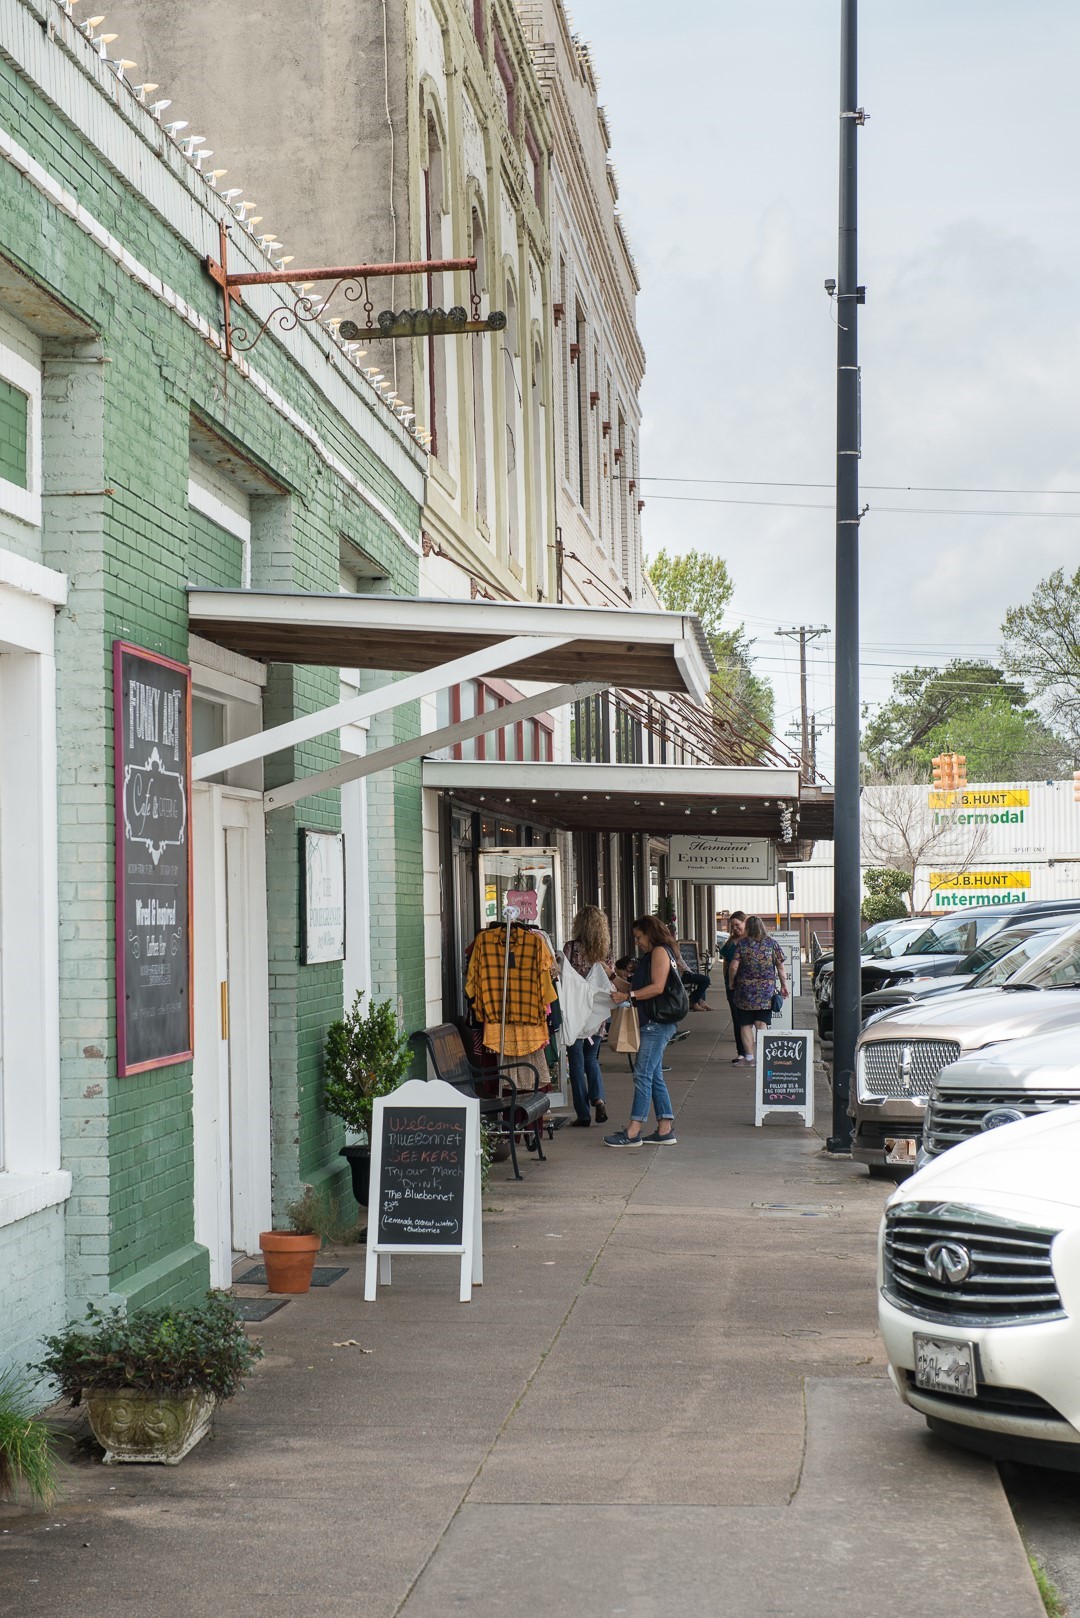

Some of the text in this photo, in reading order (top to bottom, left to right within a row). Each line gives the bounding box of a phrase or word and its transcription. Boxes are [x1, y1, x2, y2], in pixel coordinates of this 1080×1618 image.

[129, 680, 181, 762] FUNKY ART
[689, 841, 748, 852] Hermann
[678, 853, 760, 865] Emporium
[935, 891, 1026, 906] Intermodal
[135, 898, 151, 926] Wired
[157, 899, 176, 930] Inspired
[765, 1040, 803, 1061] social
[389, 1115, 465, 1132] Welcome
[388, 1150, 458, 1163] SEEKERS
[384, 1165, 464, 1181] Try our March
[384, 1188, 455, 1201] The Bluebonnet
